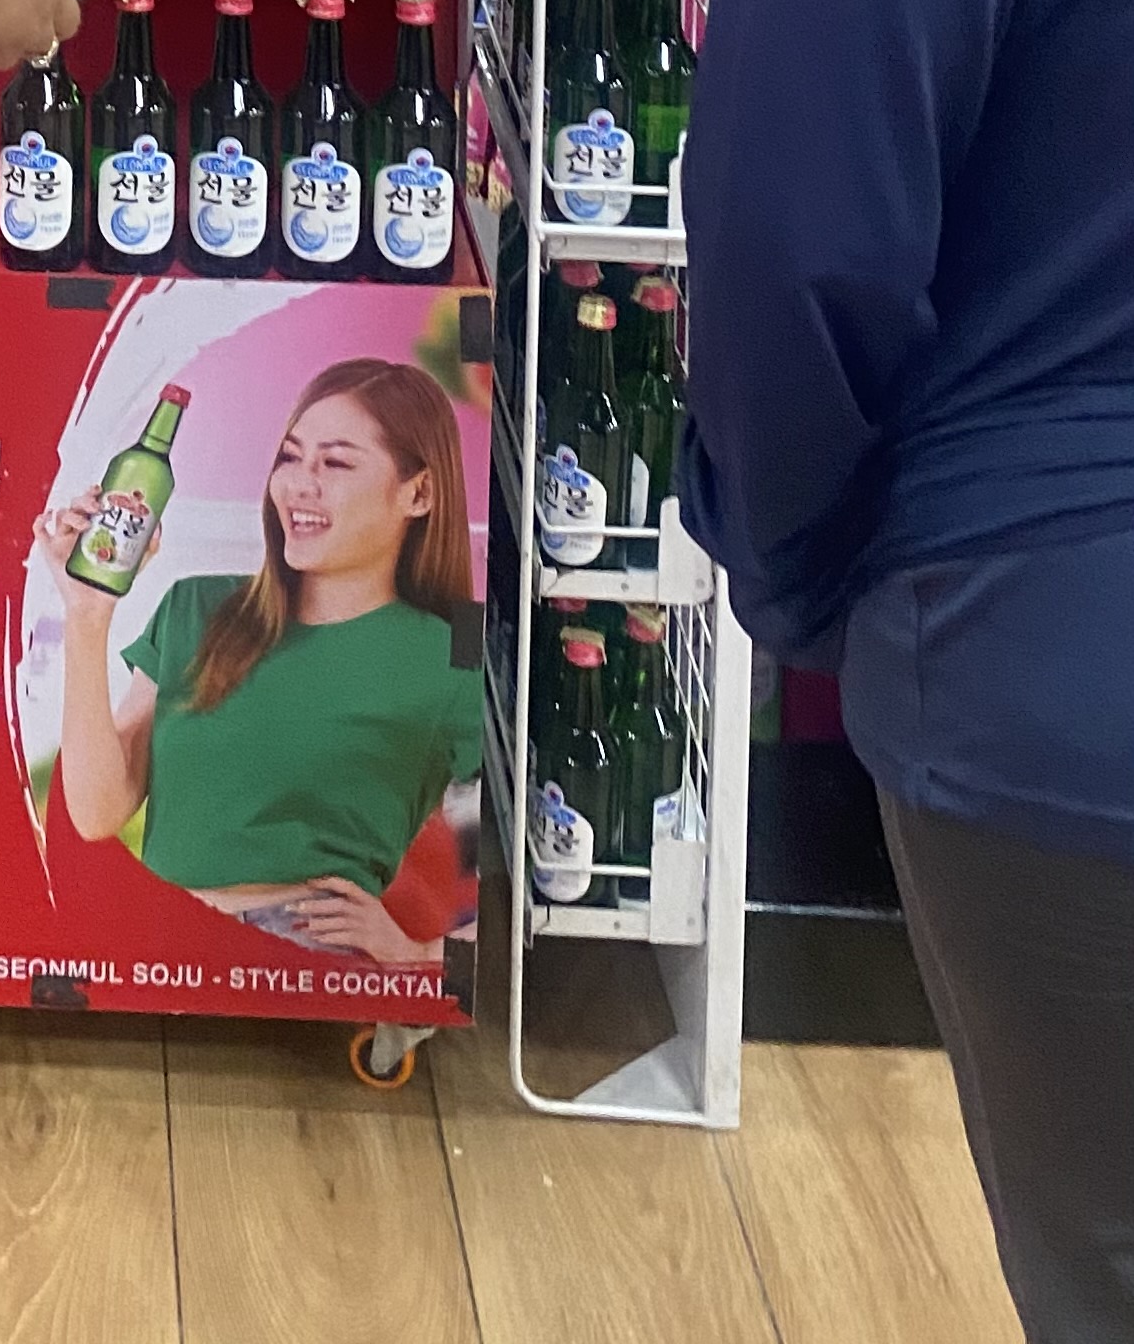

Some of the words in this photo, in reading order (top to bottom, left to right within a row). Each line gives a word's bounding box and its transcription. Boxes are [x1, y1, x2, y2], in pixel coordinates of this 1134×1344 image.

[4, 166, 61, 201] 선물
[110, 172, 169, 203] 선물
[198, 174, 257, 207] 선물
[290, 179, 351, 212] 선물
[385, 185, 445, 217] 선물
[132, 962, 203, 988] SOJU
[229, 967, 314, 994] STYLE
